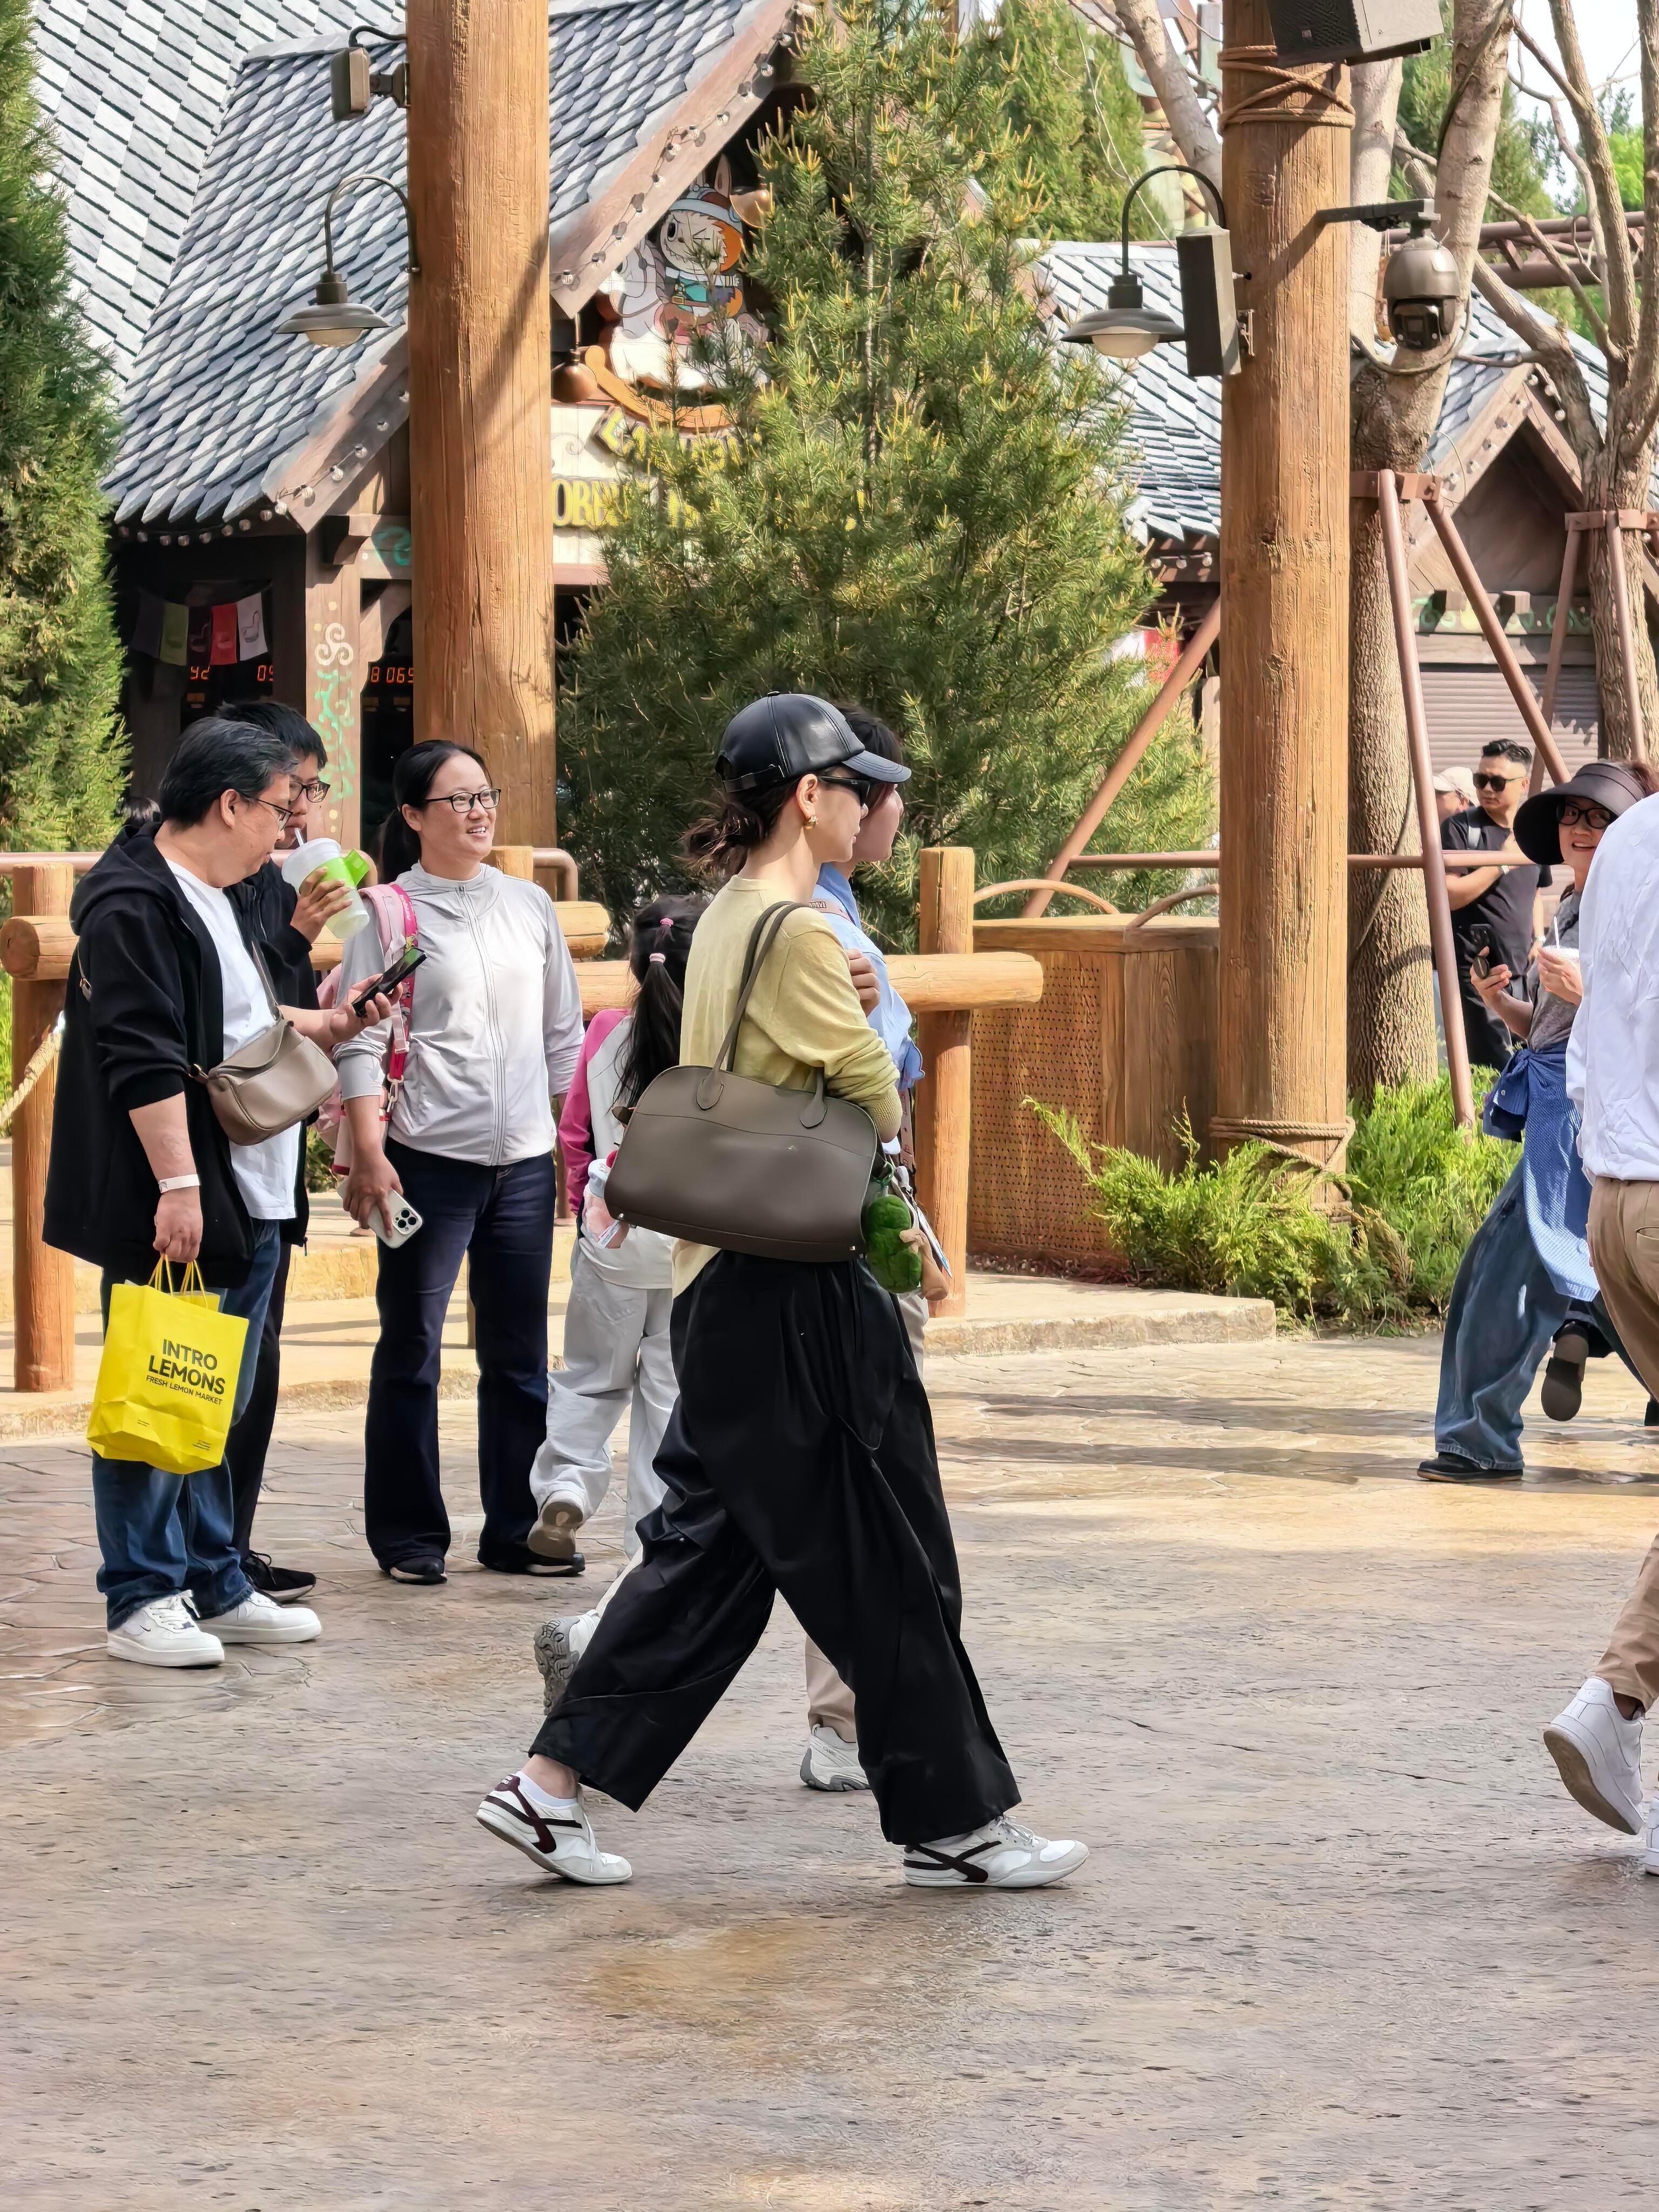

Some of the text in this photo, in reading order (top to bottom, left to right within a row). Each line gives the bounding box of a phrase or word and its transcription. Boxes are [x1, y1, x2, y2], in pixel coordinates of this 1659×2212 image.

[163, 1339, 217, 1370] INTRO
[146, 1375, 222, 1405] FRESH LEMON MARKET
[148, 1355, 226, 1395] LEMONS
